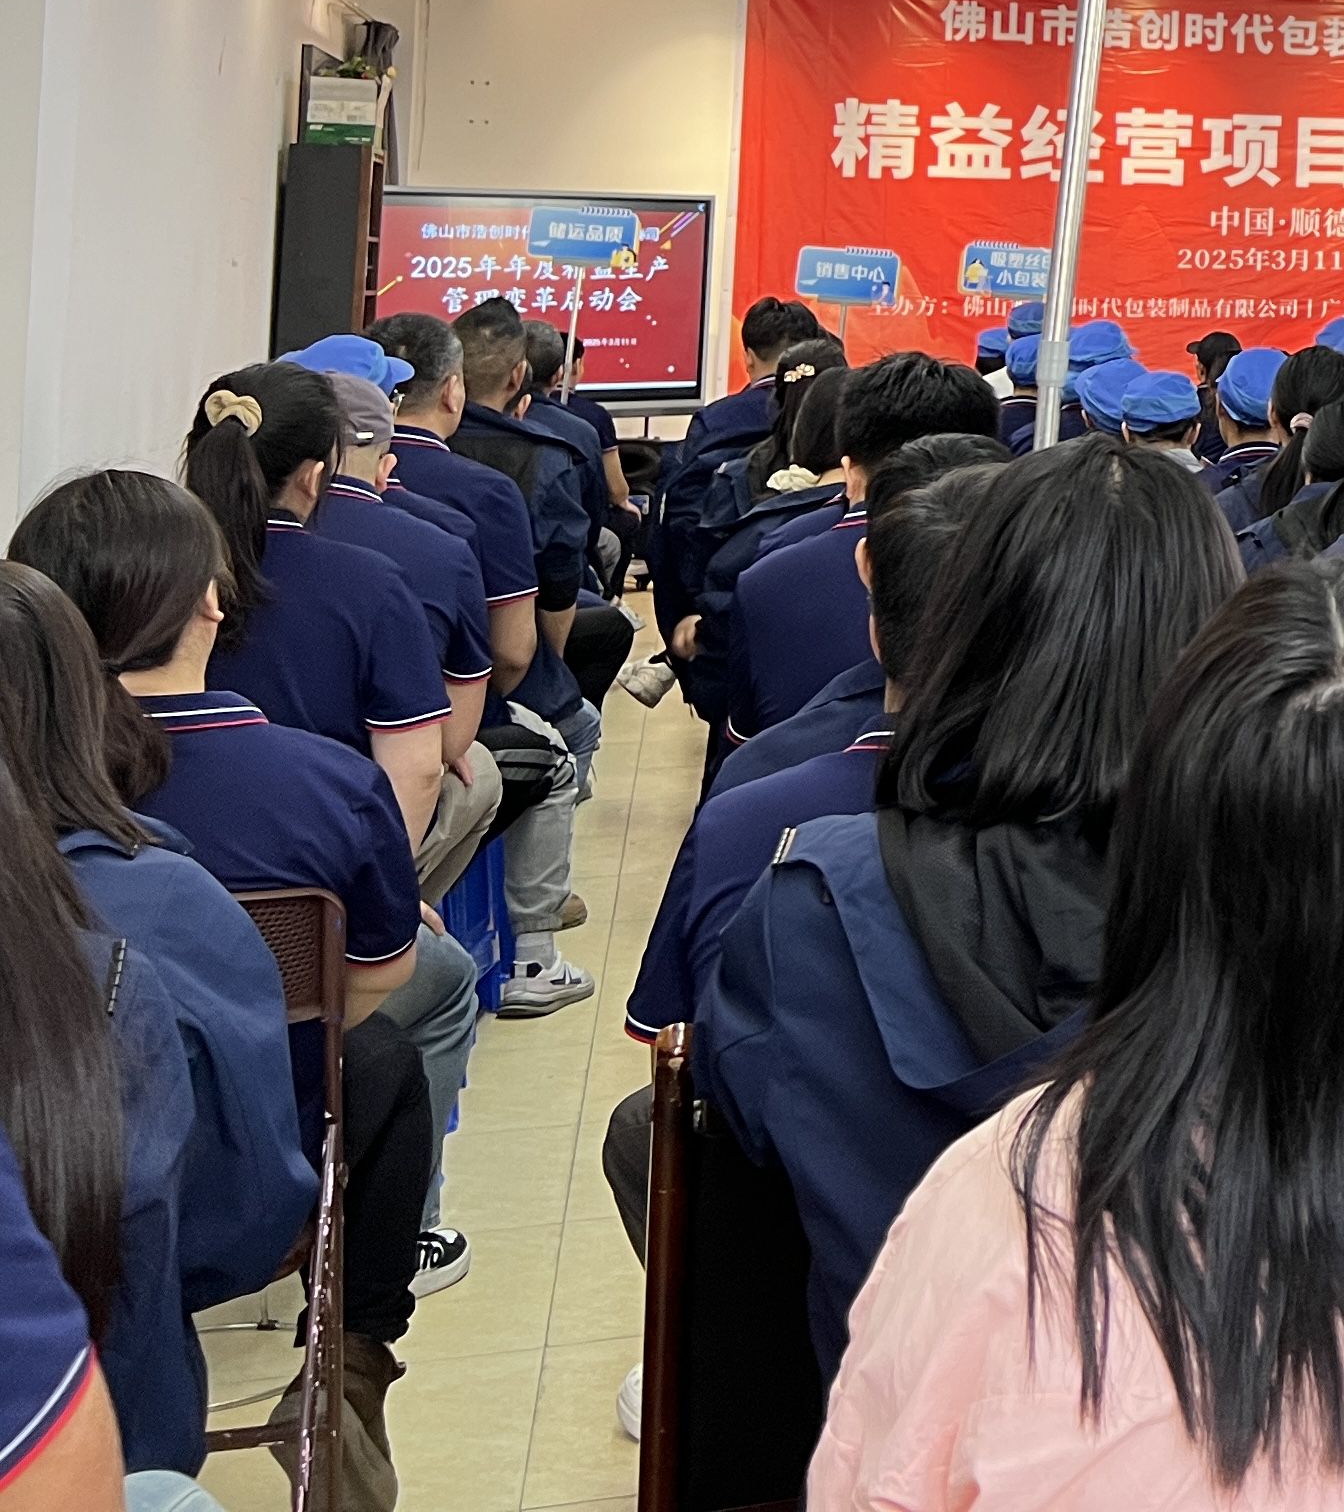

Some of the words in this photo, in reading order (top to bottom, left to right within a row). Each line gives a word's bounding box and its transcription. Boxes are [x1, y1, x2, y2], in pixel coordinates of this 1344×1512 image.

[549, 221, 624, 244] 储运品质
[815, 261, 885, 283] 销售中心
